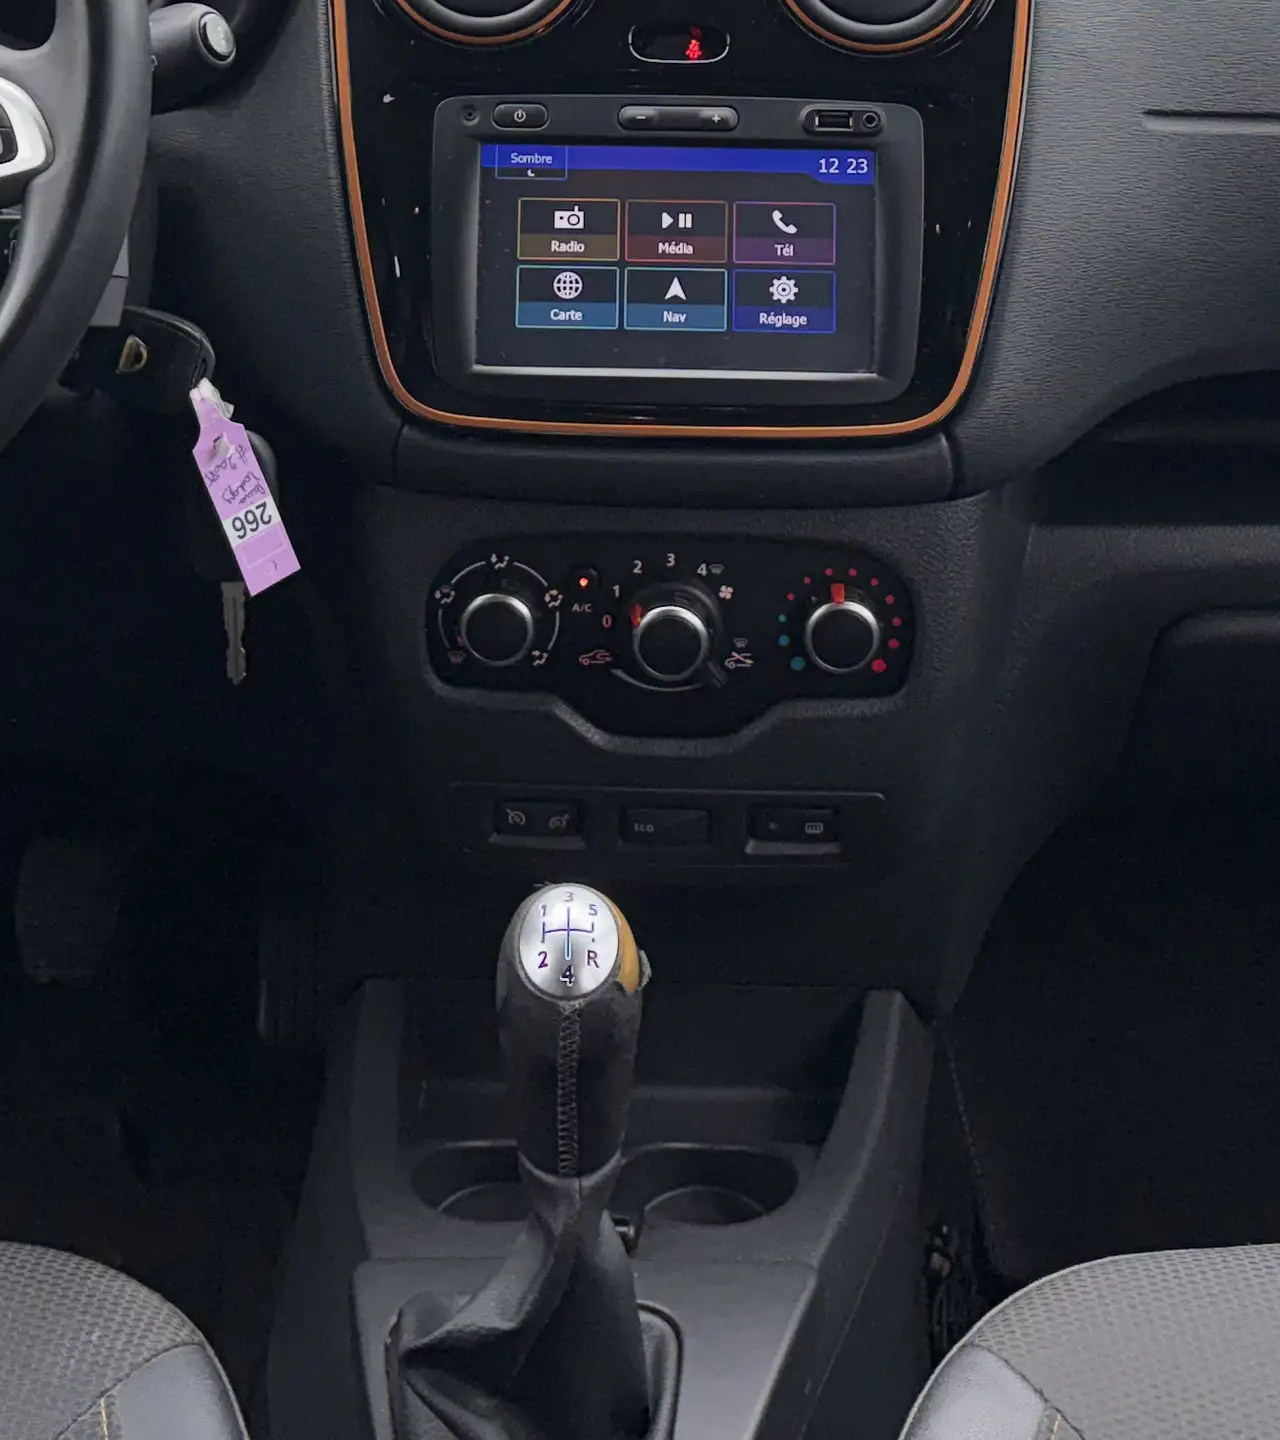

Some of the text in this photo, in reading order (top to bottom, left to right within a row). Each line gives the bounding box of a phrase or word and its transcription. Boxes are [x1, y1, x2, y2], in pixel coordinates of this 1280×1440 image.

[510, 152, 553, 165] Sombre
[818, 157, 868, 174] 12 23
[551, 240, 586, 253] Radio
[658, 240, 694, 255] Média
[774, 243, 794, 257] Tél
[550, 308, 583, 321] Carte
[663, 310, 687, 323] Nav
[758, 311, 808, 328] Réglage
[231, 501, 272, 540] 266
[633, 560, 643, 574] 2
[666, 553, 676, 567] 3
[696, 563, 708, 576] 4
[612, 584, 620, 598] 1
[571, 603, 593, 612] A/C
[633, 822, 655, 833] ECO
[563, 890, 574, 903] 3
[539, 904, 547, 917] 1
[588, 903, 599, 916] 5
[537, 950, 549, 969] 2
[587, 950, 600, 969] R
[560, 964, 575, 985] 4
